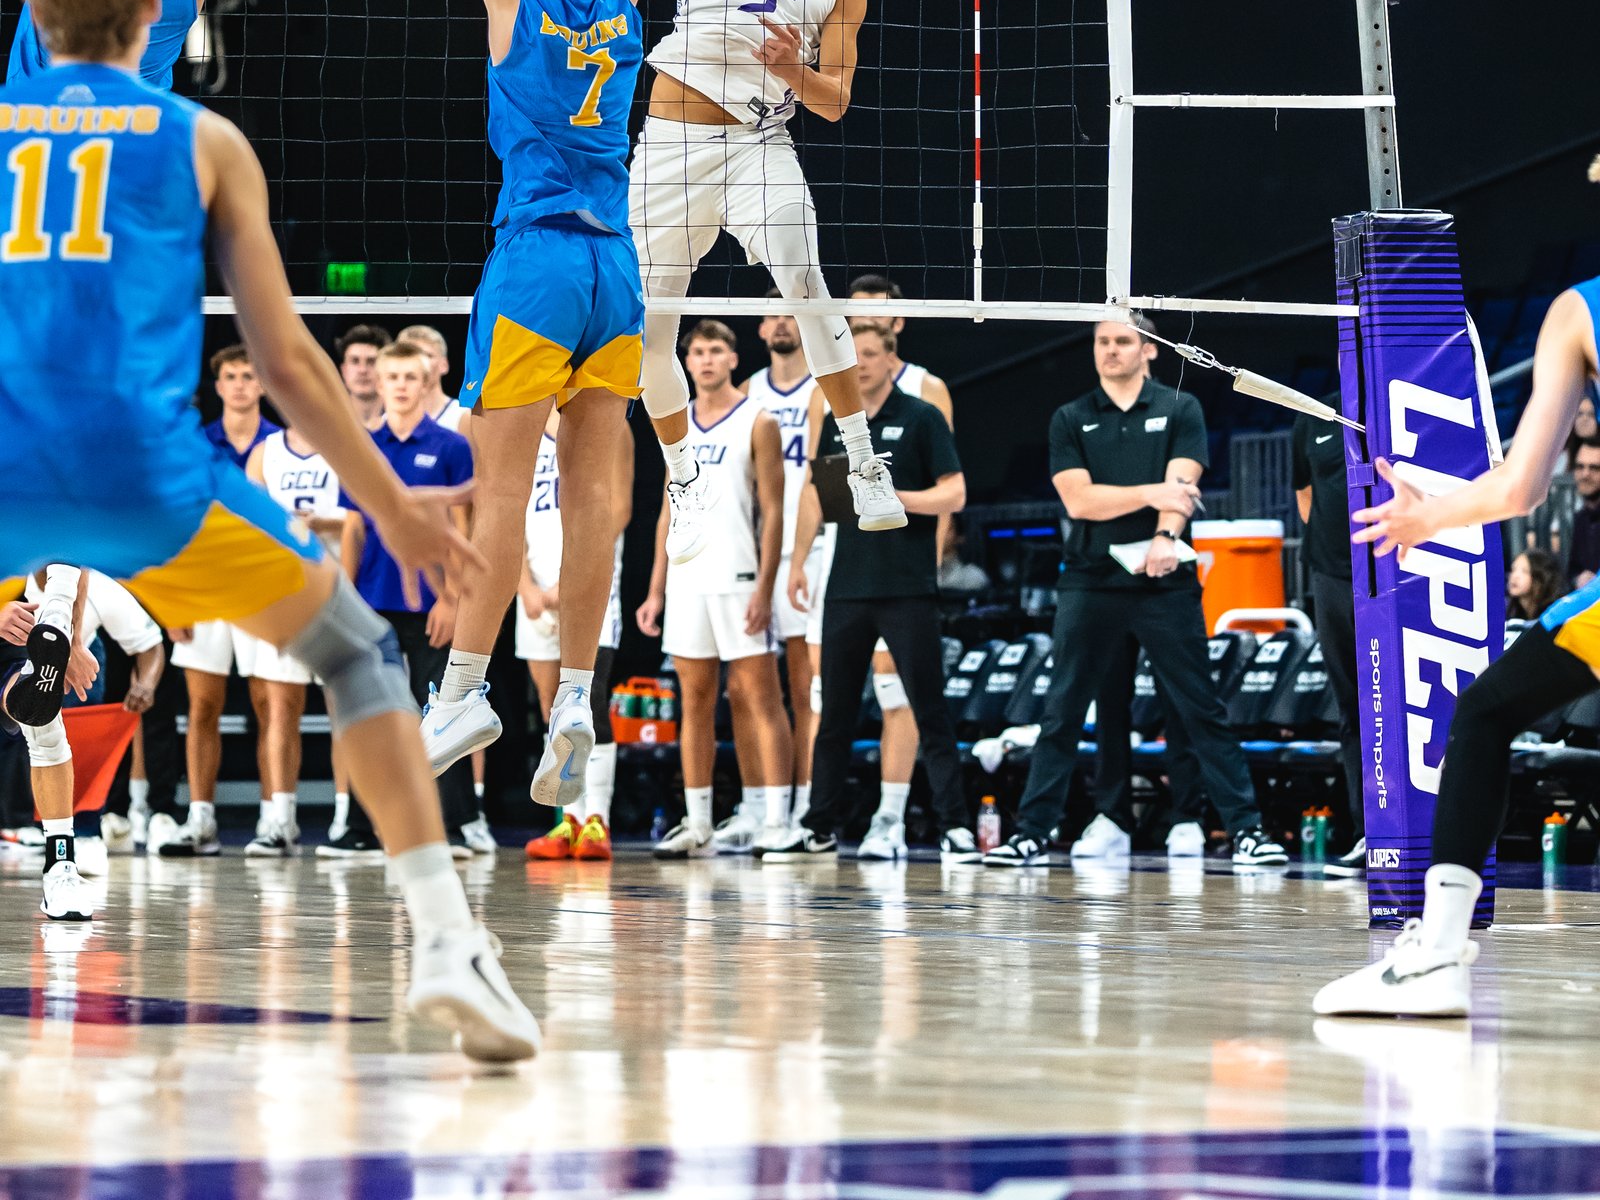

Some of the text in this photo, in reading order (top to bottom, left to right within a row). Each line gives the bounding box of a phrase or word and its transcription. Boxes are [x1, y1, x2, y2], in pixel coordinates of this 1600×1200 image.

[566, 46, 617, 127] 7
[0, 137, 114, 263] 11
[692, 444, 728, 464] CU
[783, 434, 807, 468] 4
[280, 469, 329, 490] GCU
[1370, 637, 1388, 810] sports imports
[1368, 848, 1400, 868] LOPES
